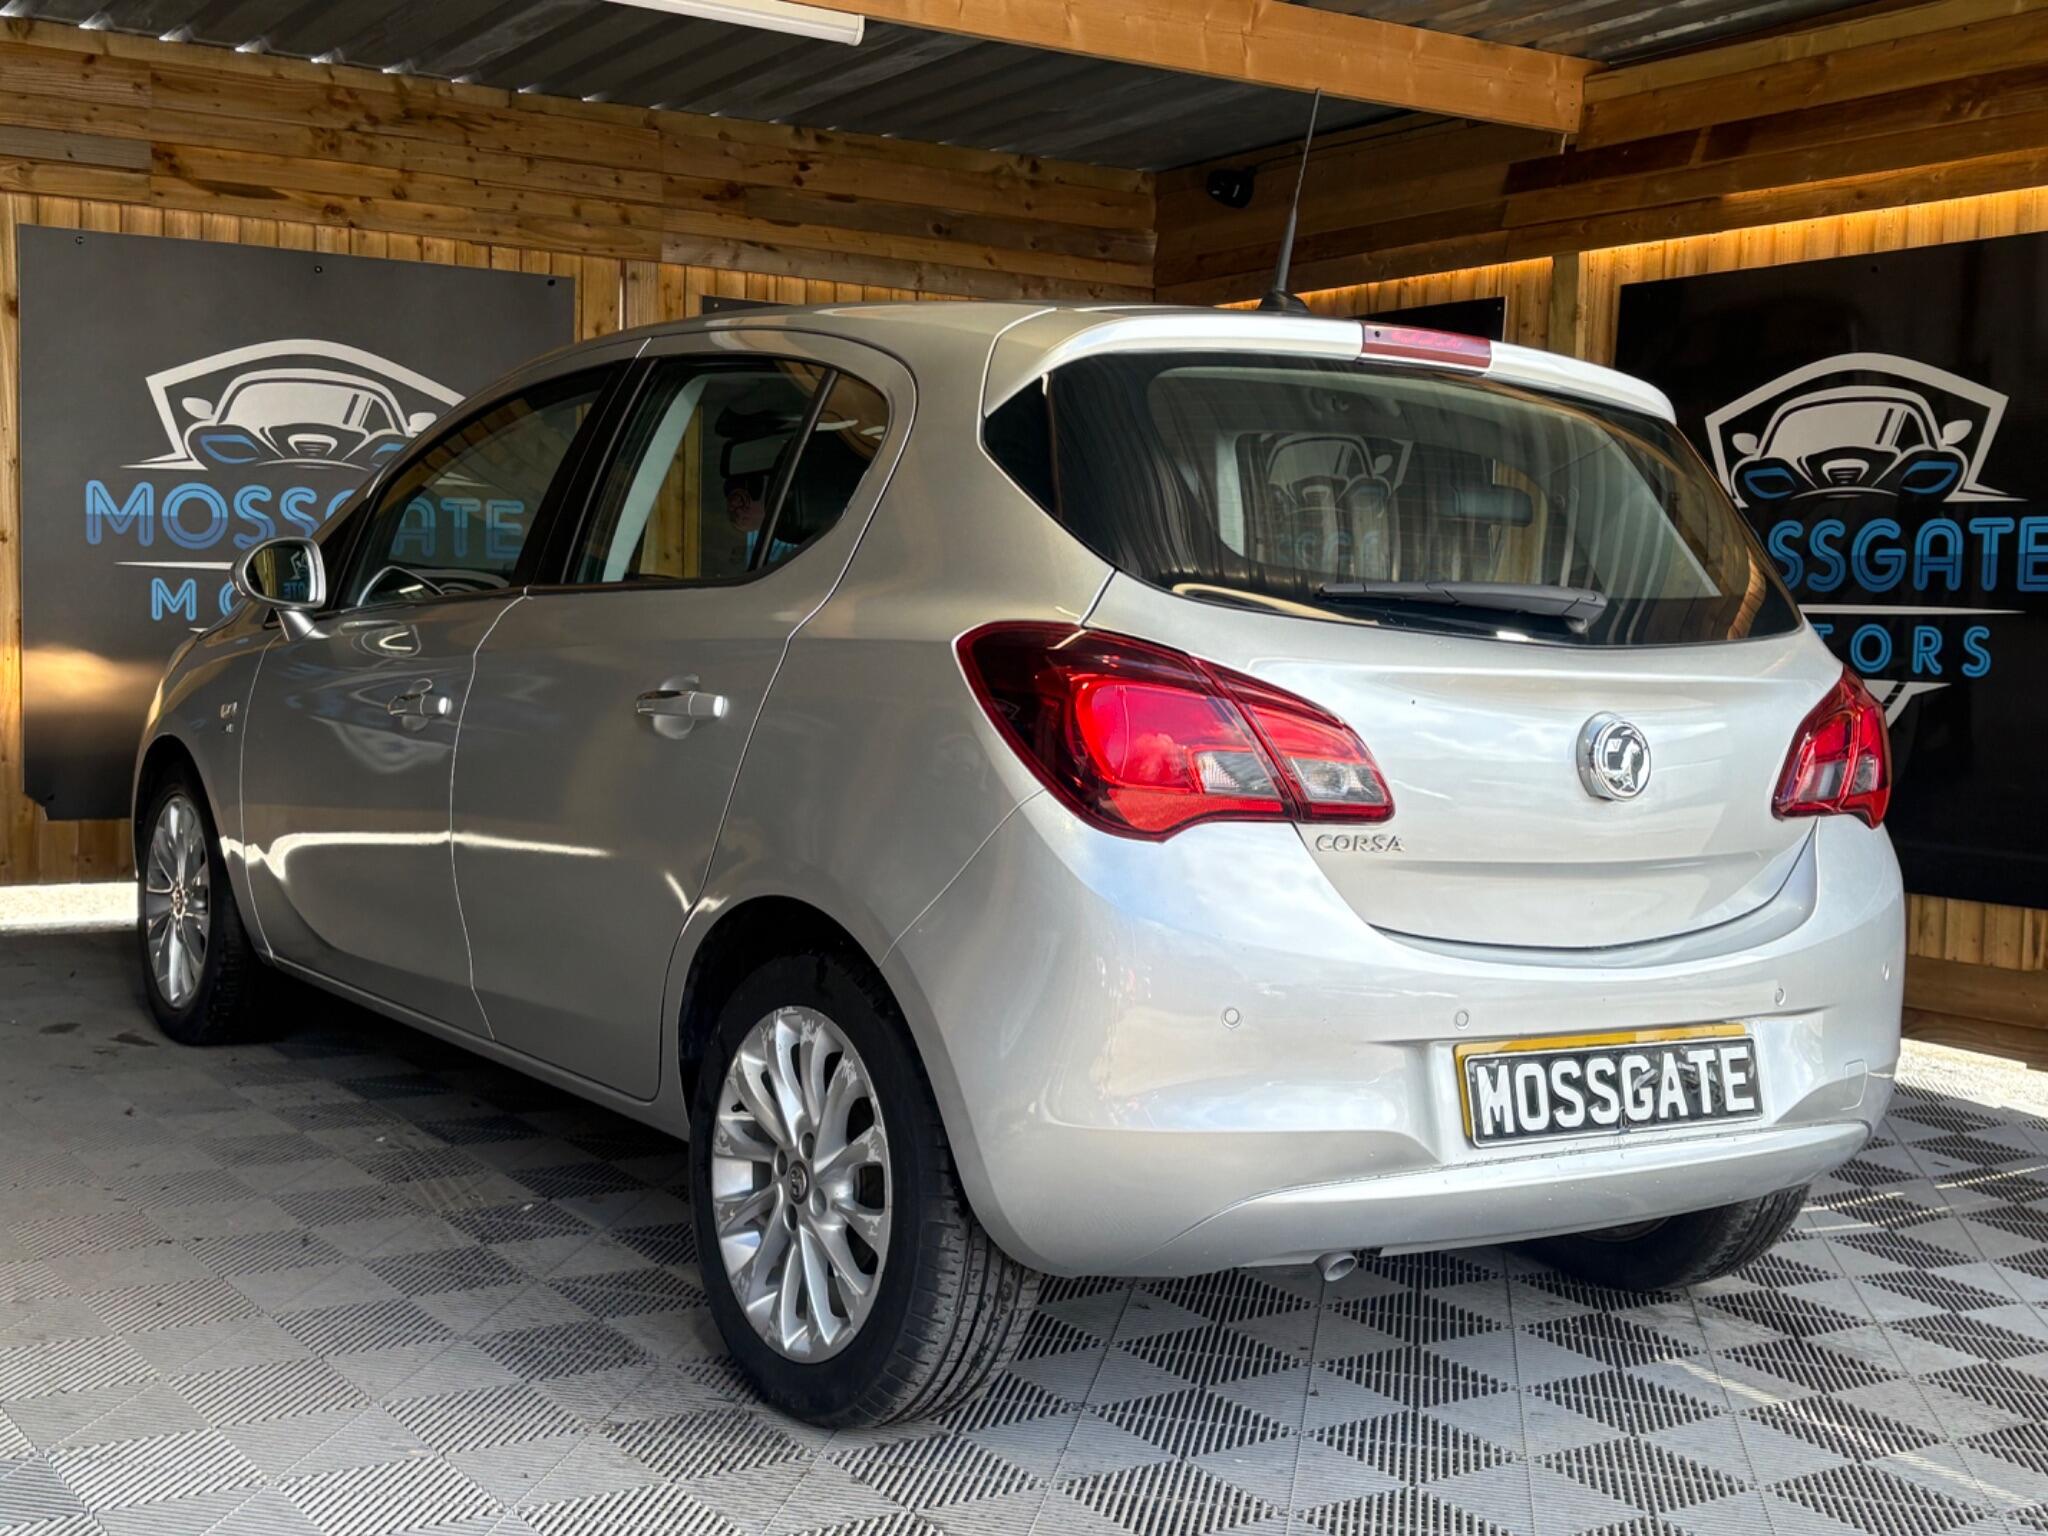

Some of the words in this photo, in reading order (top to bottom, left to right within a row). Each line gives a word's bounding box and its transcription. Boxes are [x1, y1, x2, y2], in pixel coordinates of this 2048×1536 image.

[84, 478, 526, 560] MOSSATE
[1766, 516, 2048, 593] SSGATE
[1315, 833, 1406, 853] CORSA
[1475, 1045, 1755, 1136] MOSSGATE
